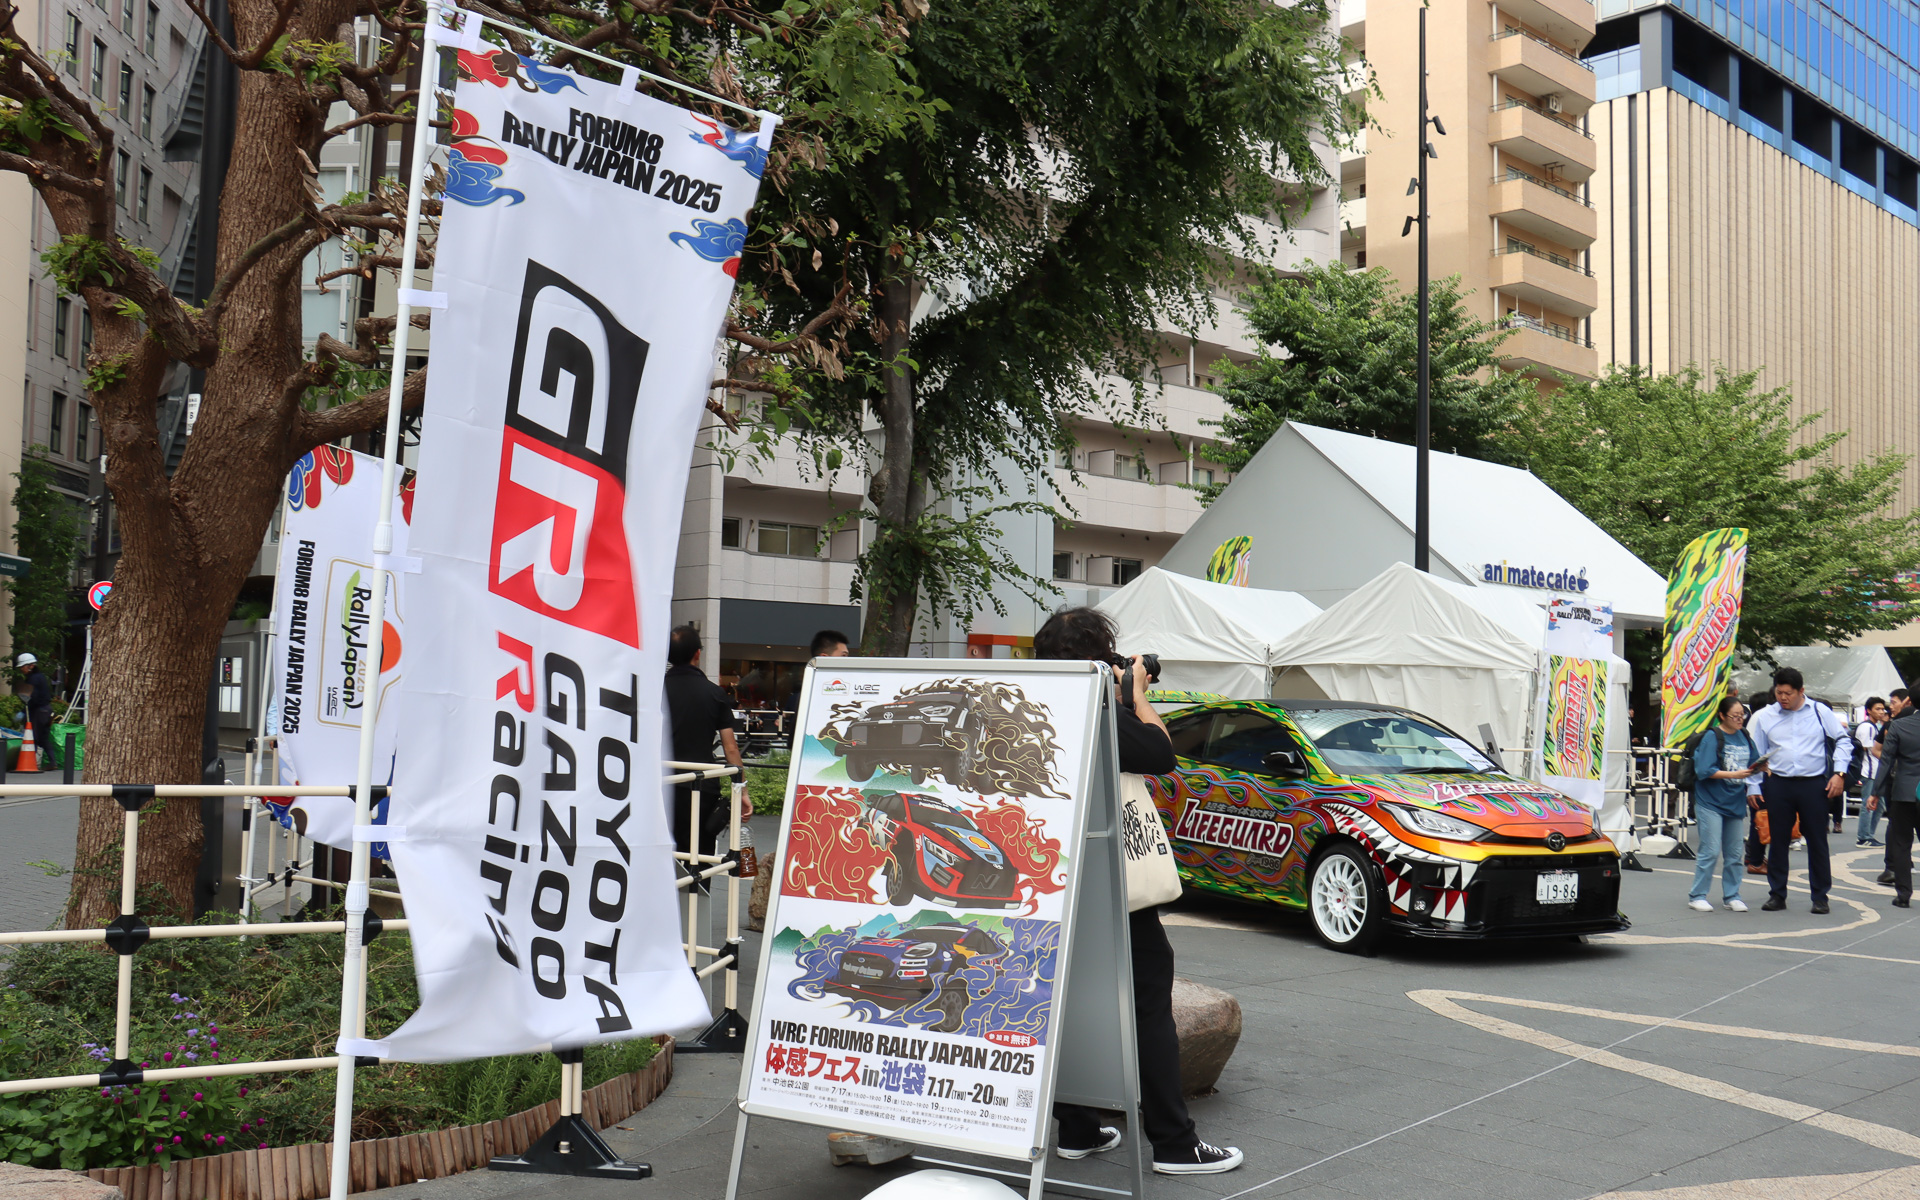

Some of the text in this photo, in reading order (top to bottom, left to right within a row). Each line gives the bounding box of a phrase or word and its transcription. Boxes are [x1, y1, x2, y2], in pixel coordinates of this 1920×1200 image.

[501, 110, 723, 214] RALLY JAPAN 2025
[568, 107, 665, 165] FORUM8
[282, 539, 316, 734] FORUM8 RALLY JAPAN 2025
[1667, 593, 1739, 704] LIFEGUARD
[1563, 670, 1587, 763] LIFEGUARD
[480, 630, 537, 975] Racing
[530, 651, 587, 1001] GAZOO
[583, 672, 639, 1034] TOYOTA
[1174, 798, 1295, 859] LIFEGUARD
[770, 1019, 1035, 1076] WRC FORUM8 RALLY JAPAN 2025
[772, 1077, 810, 1091] 中池袋公園
